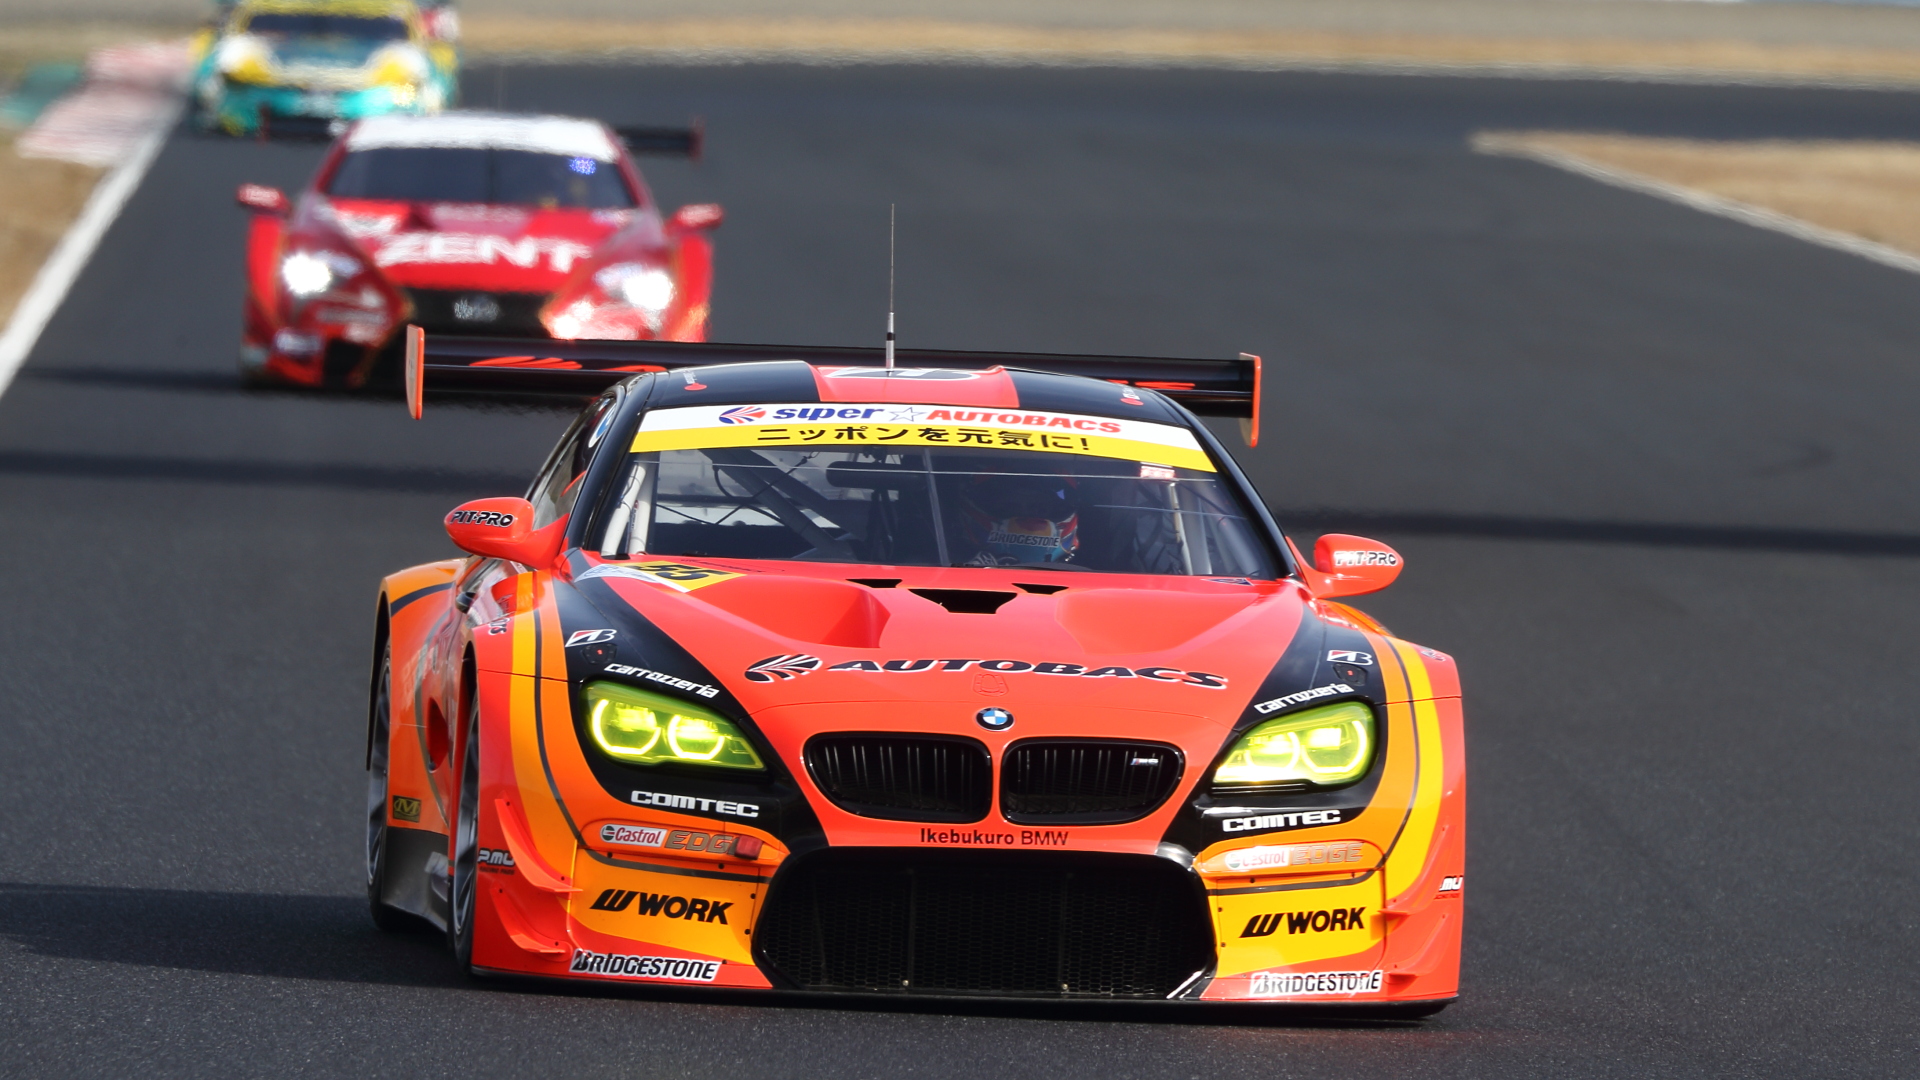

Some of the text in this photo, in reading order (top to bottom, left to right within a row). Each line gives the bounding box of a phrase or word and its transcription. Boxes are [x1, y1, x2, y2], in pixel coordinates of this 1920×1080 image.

[375, 231, 592, 273] ZENT
[772, 407, 1122, 433] super AUTOBACS
[988, 531, 1060, 547] BRIDGESTONE
[603, 662, 721, 699] carrozzeria
[827, 659, 1229, 690] AUTOBACS
[1253, 682, 1355, 714] carrozzeria
[630, 789, 760, 818] COMTEC
[1222, 809, 1342, 832] COMTEC
[615, 826, 737, 856] Castrol EDG
[920, 828, 1069, 846] Ikebukuro BMW
[1290, 841, 1366, 866] EDGE
[638, 892, 735, 926] WORK
[1286, 906, 1367, 935] WORK
[572, 950, 718, 980] BRIDGESTONE
[1253, 970, 1382, 995] BRIDGESTONE
